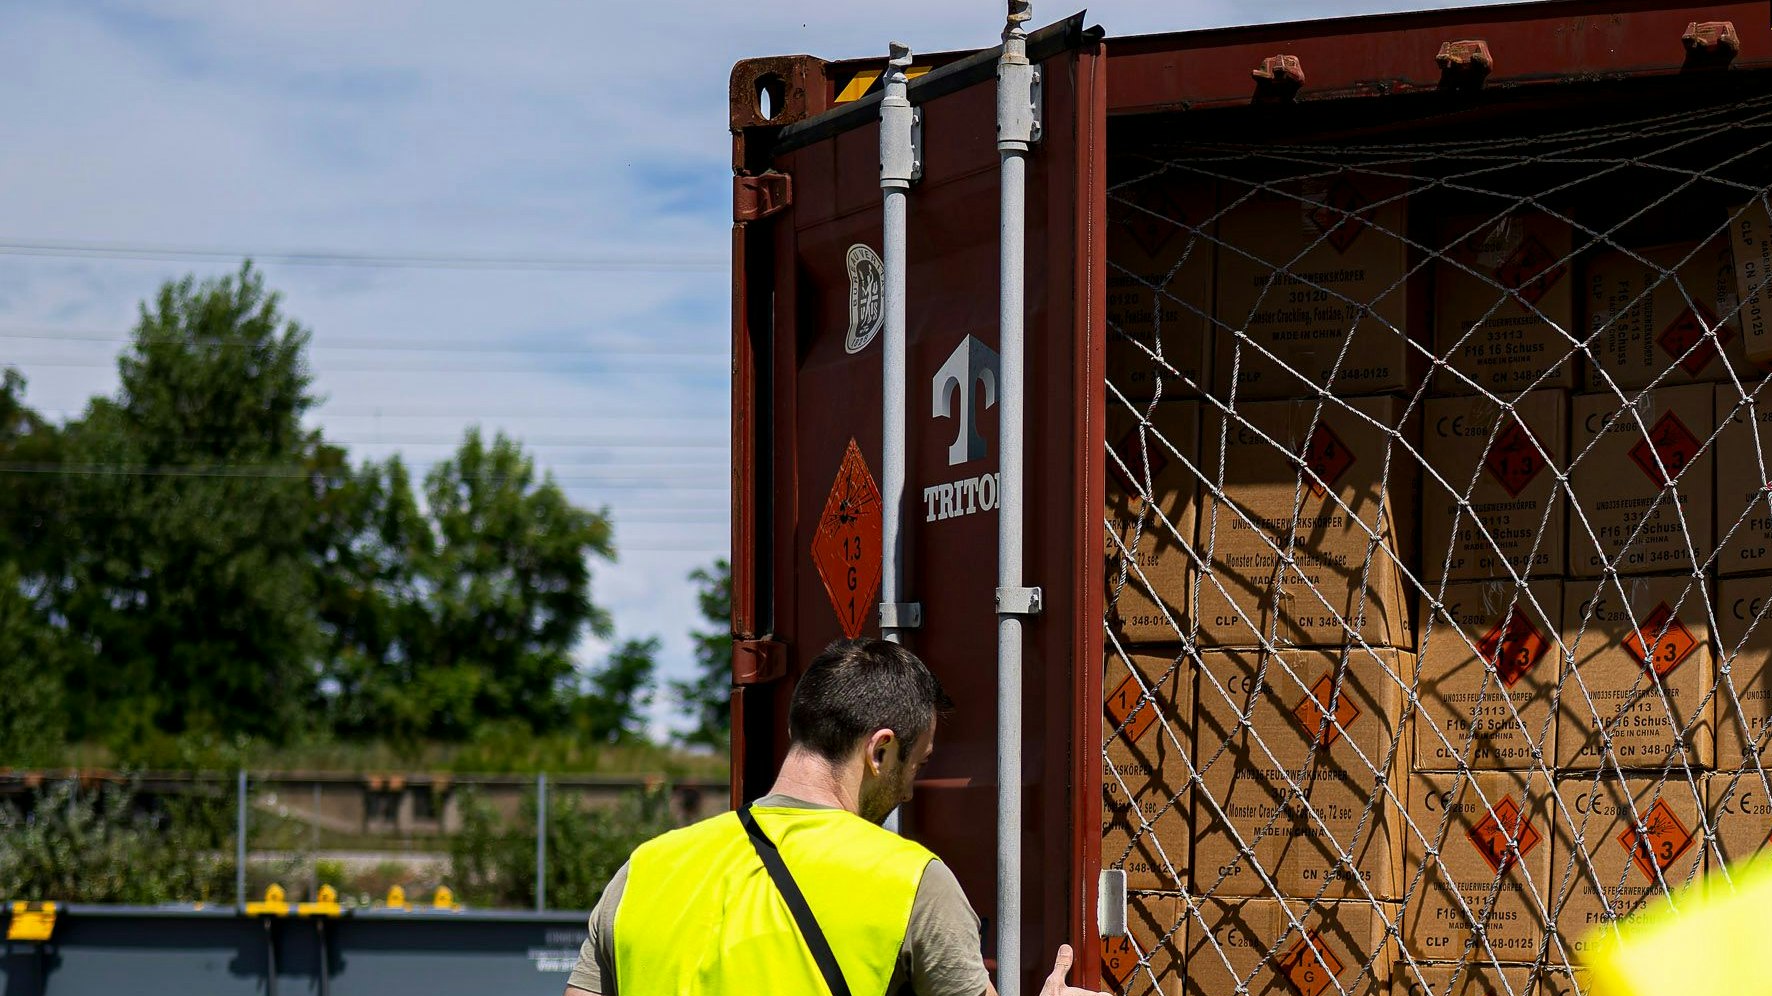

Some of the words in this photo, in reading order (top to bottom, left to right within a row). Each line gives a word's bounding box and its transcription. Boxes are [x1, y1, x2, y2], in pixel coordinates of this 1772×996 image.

[1741, 220, 1753, 246] CLP
[1745, 262, 1756, 279] CN
[1614, 422, 1637, 433] 2806
[924, 472, 1000, 522] TRITO
[1600, 525, 1620, 538] F16
[1643, 519, 1684, 534] Schuss
[843, 536, 861, 562] 1.3
[1741, 548, 1766, 559] CLP
[1226, 553, 1253, 567] Monster
[1334, 555, 1347, 567] sec
[1629, 552, 1644, 564] CN
[847, 566, 857, 593] G
[1250, 575, 1275, 585] MADE
[1215, 616, 1239, 627] CLP
[1299, 615, 1314, 627] CN
[1462, 614, 1486, 626] 2806
[1487, 717, 1528, 730] Schuss
[1636, 729, 1661, 737] CHINA
[1474, 748, 1490, 759] CN
[1619, 746, 1636, 757] CN
[1144, 803, 1157, 814] sec
[1575, 793, 1604, 815] CE
[1603, 806, 1628, 816] 2806
[1229, 804, 1257, 818] Monster
[1329, 807, 1338, 818] 72
[1339, 808, 1352, 819] sec
[1254, 827, 1280, 836] MADE
[1303, 869, 1318, 880] CN
[1436, 908, 1456, 920] F16
[1426, 937, 1450, 948] CLP
[1109, 957, 1120, 969] G
[1304, 970, 1315, 983] G
